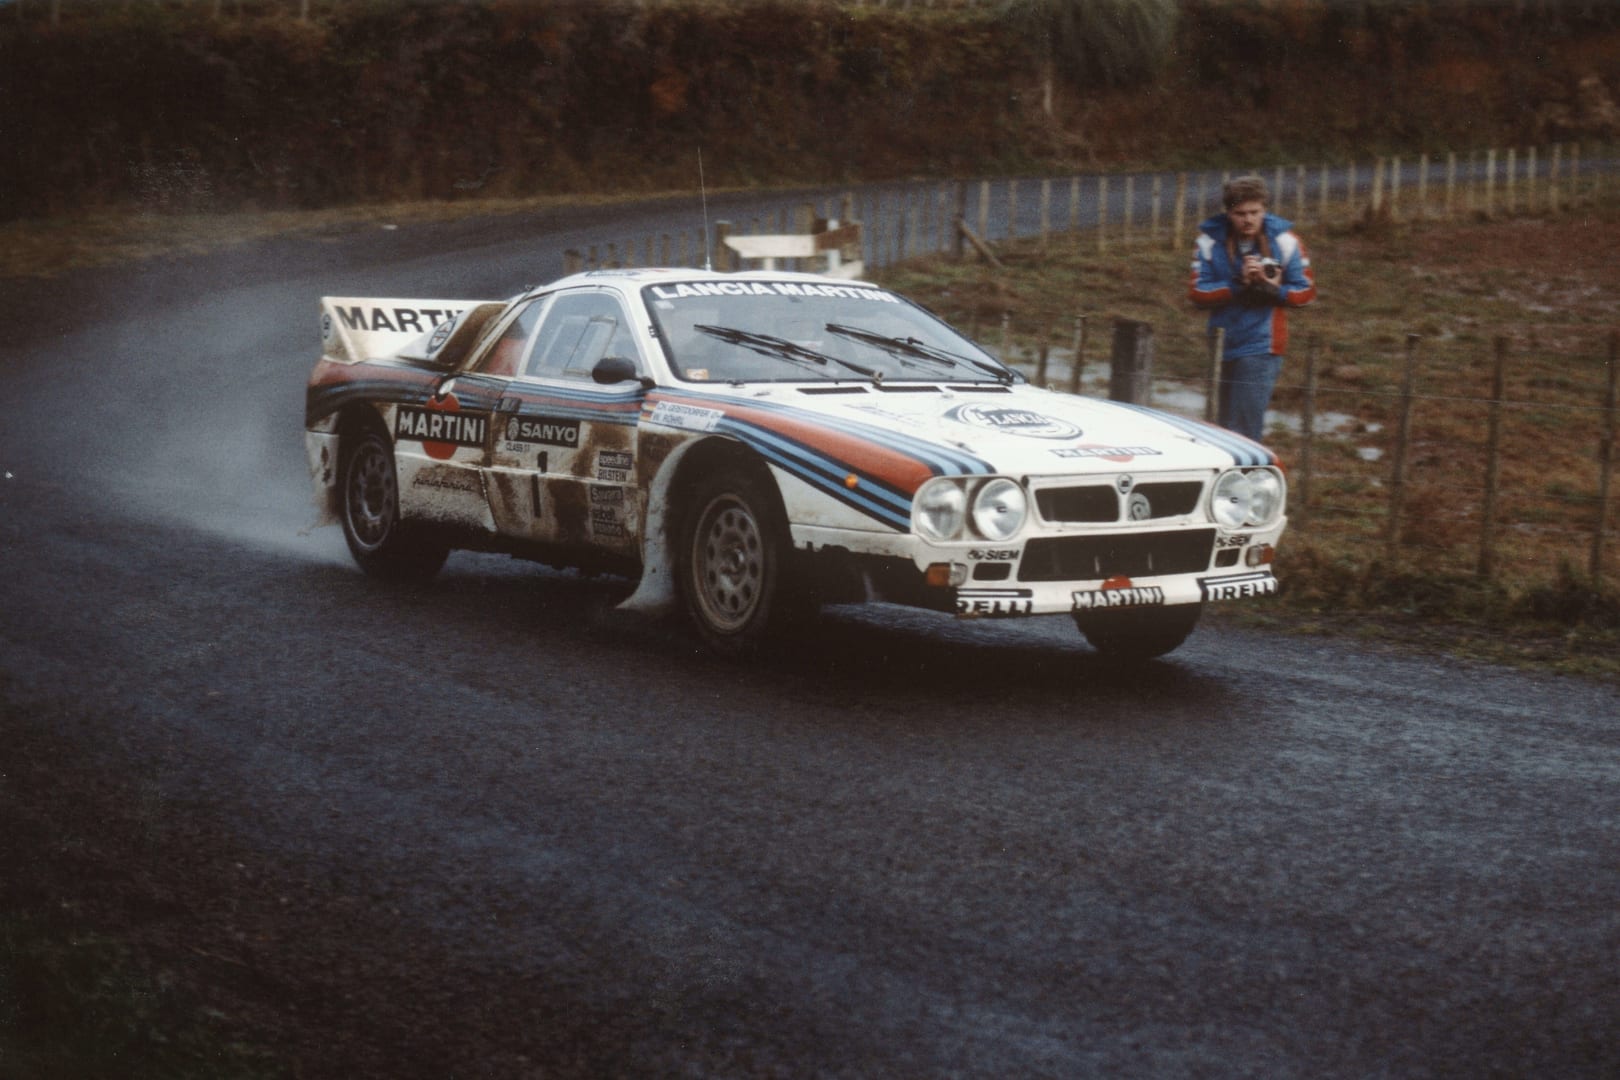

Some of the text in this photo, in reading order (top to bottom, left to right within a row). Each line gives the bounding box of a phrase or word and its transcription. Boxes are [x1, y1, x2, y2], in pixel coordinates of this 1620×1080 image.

[651, 282, 900, 304] LANCIA MARTINI
[333, 305, 464, 333] MART
[398, 411, 485, 443] MARTINI
[989, 413, 1049, 425] LANCIA
[520, 422, 577, 442] SANYO
[1054, 447, 1156, 458] MARTINI
[598, 469, 627, 482] BILSTEIN
[984, 549, 1020, 560] SIEM
[1072, 587, 1163, 608] MARTINI
